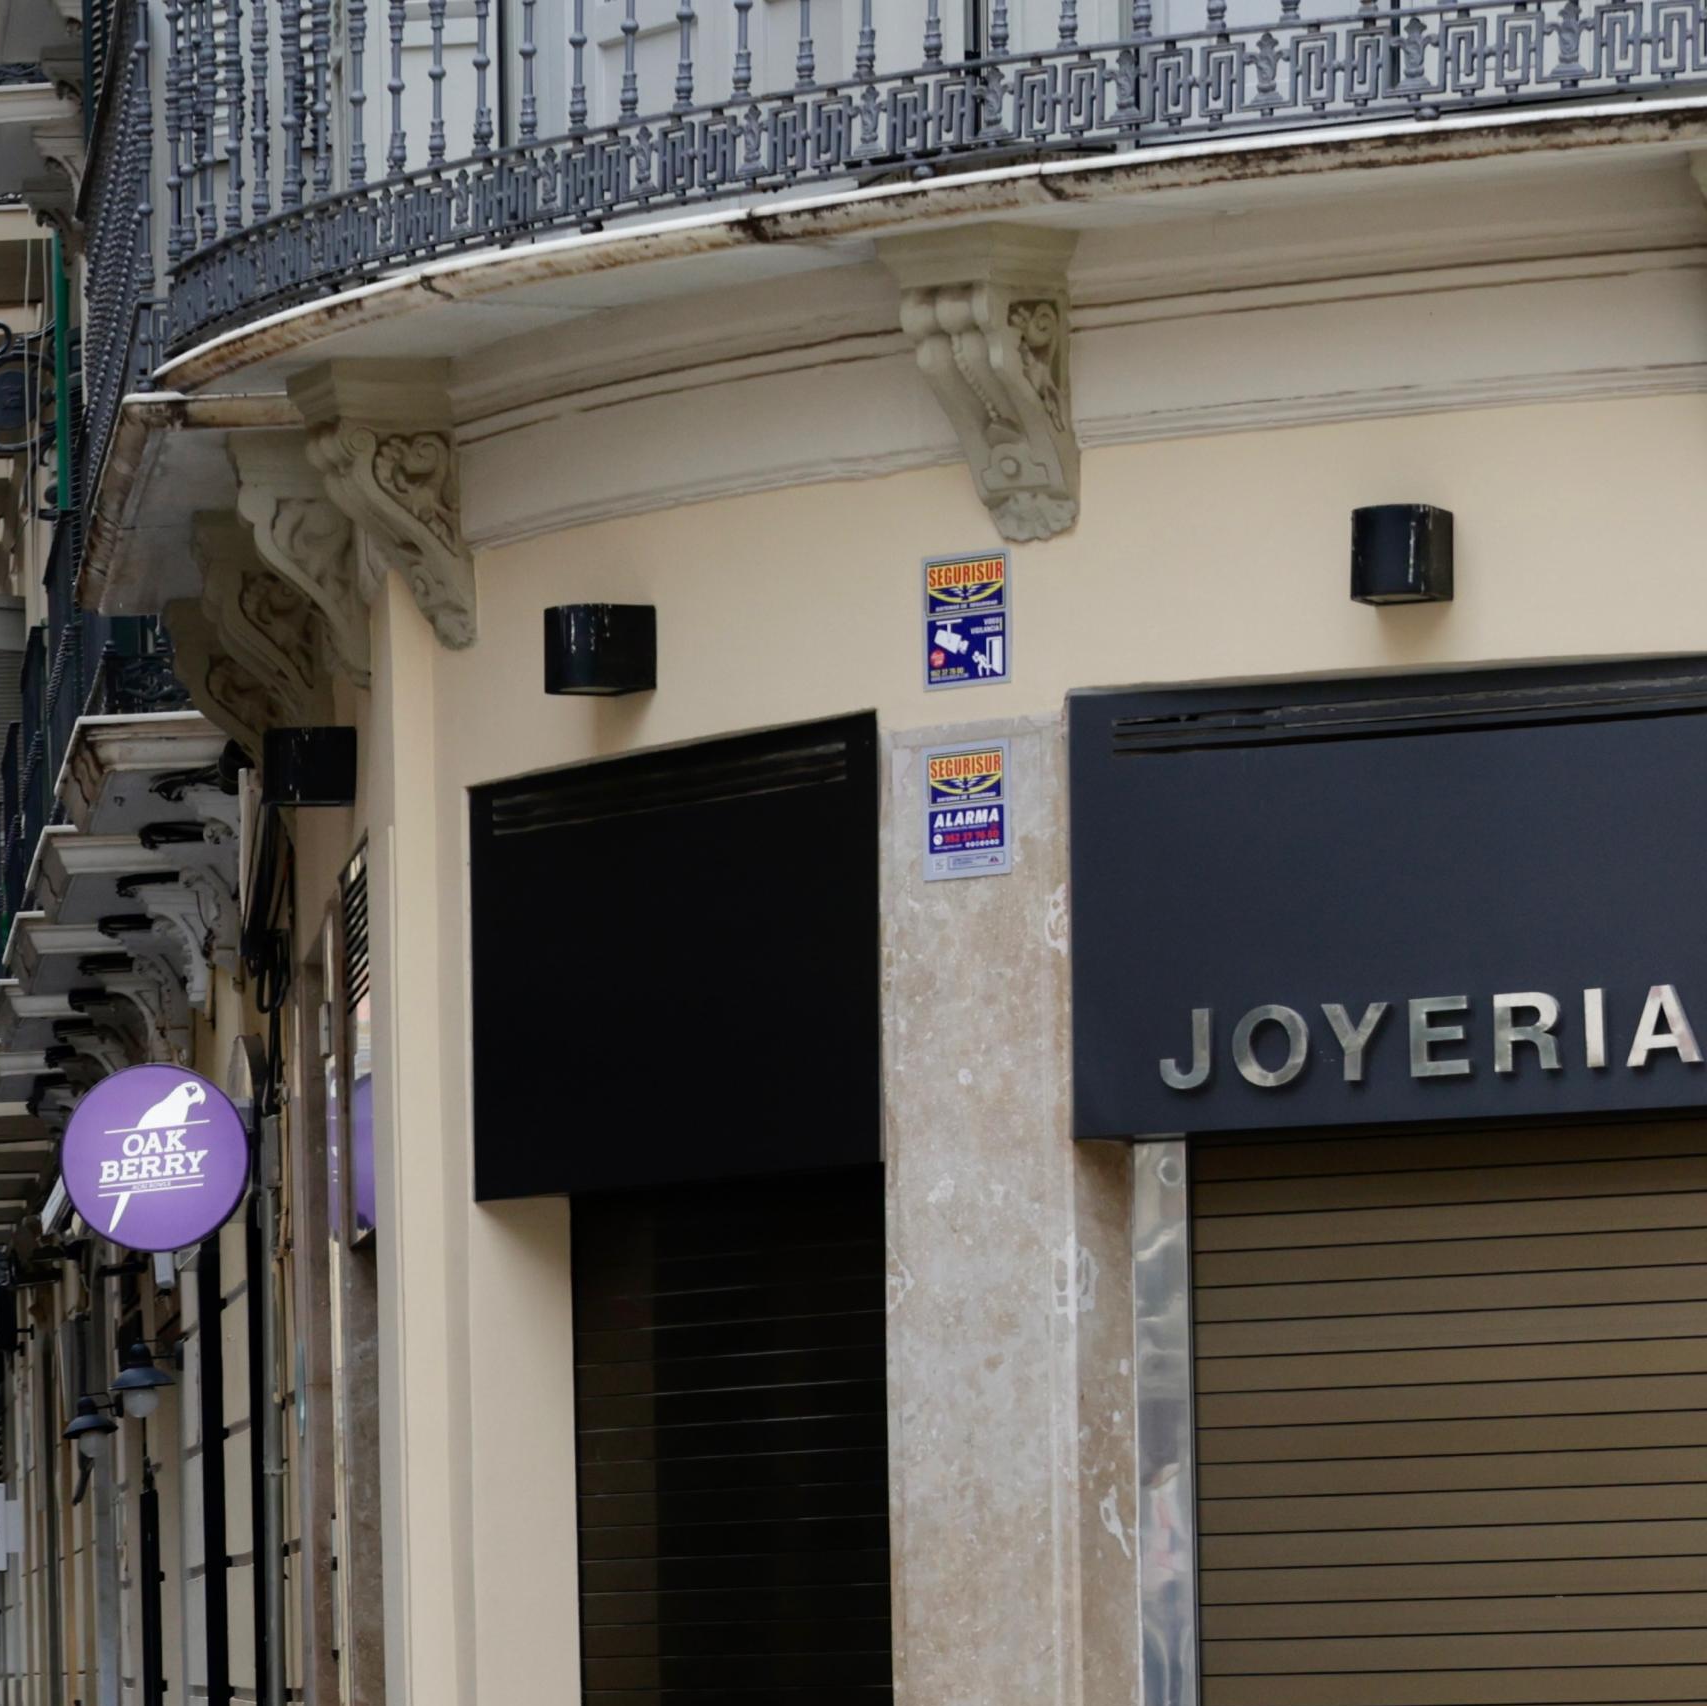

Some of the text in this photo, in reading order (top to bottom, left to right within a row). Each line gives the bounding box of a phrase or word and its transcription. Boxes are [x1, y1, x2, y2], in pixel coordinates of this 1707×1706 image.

[928, 560, 1003, 588] SEGURISUR
[930, 753, 1001, 780] SEGURISUR
[933, 807, 999, 829] ALARMA
[1158, 983, 1706, 1091] JOYERIA
[122, 1128, 187, 1157] OAK
[98, 1149, 209, 1184] BERRY
